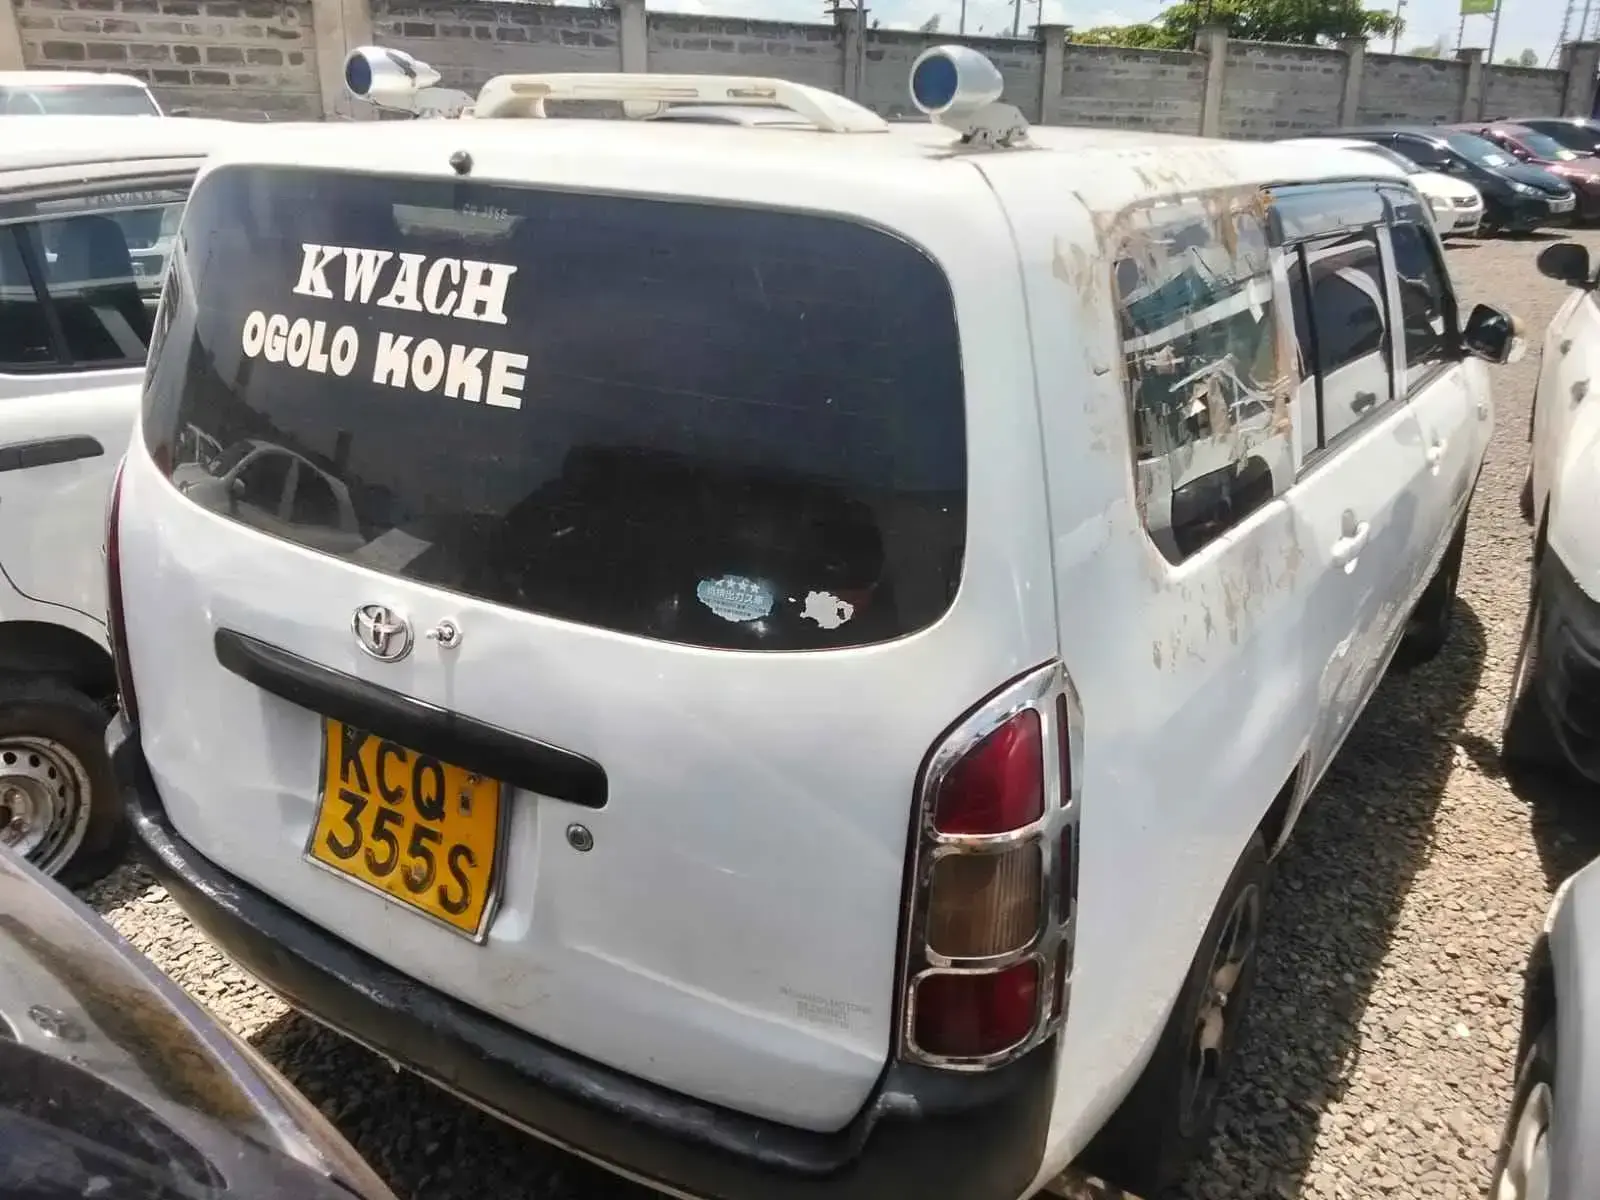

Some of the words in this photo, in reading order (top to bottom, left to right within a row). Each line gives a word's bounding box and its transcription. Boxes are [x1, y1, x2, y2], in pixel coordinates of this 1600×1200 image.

[292, 243, 518, 325] KWACH
[242, 310, 359, 377] OGOLO
[373, 331, 529, 409] KOKE
[340, 722, 446, 822] KCQ
[326, 788, 477, 914] 355S
